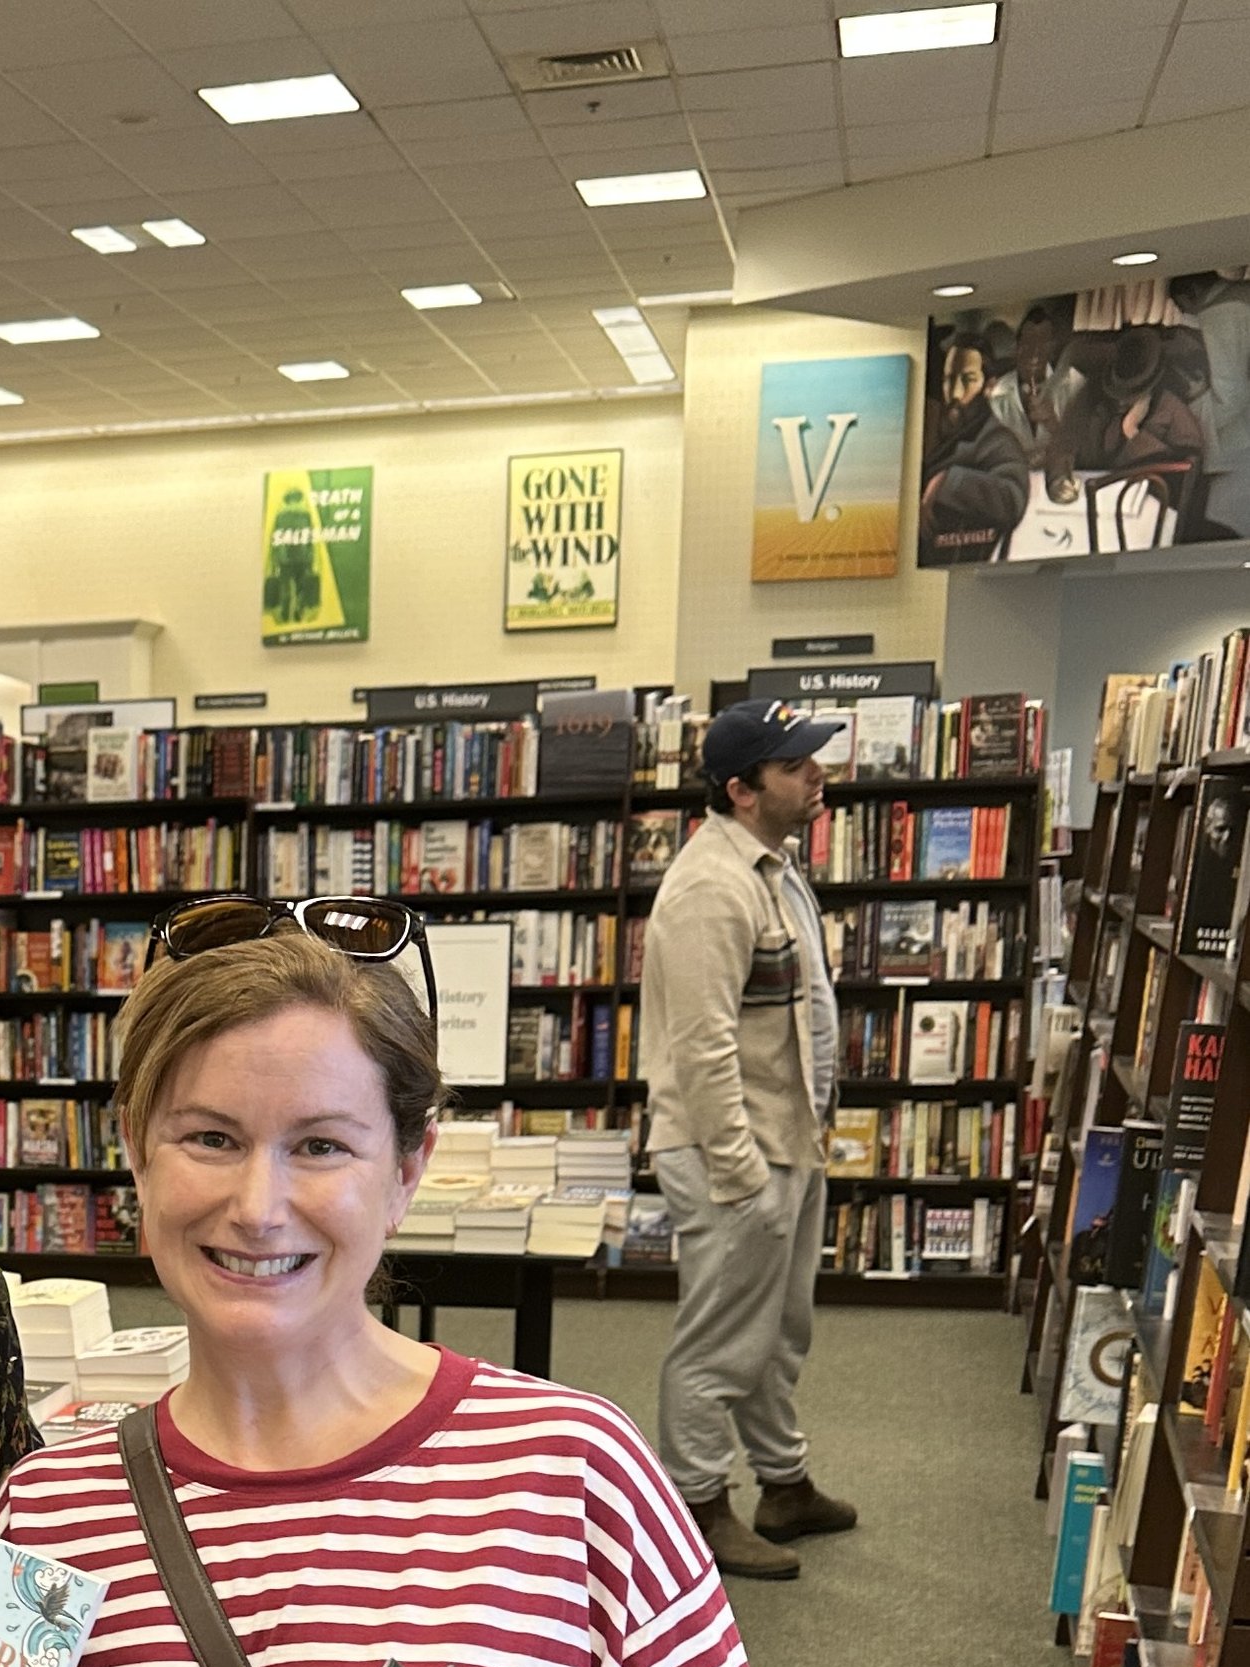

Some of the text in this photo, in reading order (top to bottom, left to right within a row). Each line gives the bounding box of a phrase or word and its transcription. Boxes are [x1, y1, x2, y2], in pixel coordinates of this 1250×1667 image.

[522, 463, 608, 500] GONE
[310, 488, 363, 505] DEATH
[521, 501, 604, 535] WITH
[272, 525, 361, 545] SALESMAN
[530, 534, 620, 567] WIND
[800, 674, 882, 691] U.S. History
[414, 692, 490, 709] U.S. History
[556, 711, 613, 736] 1619
